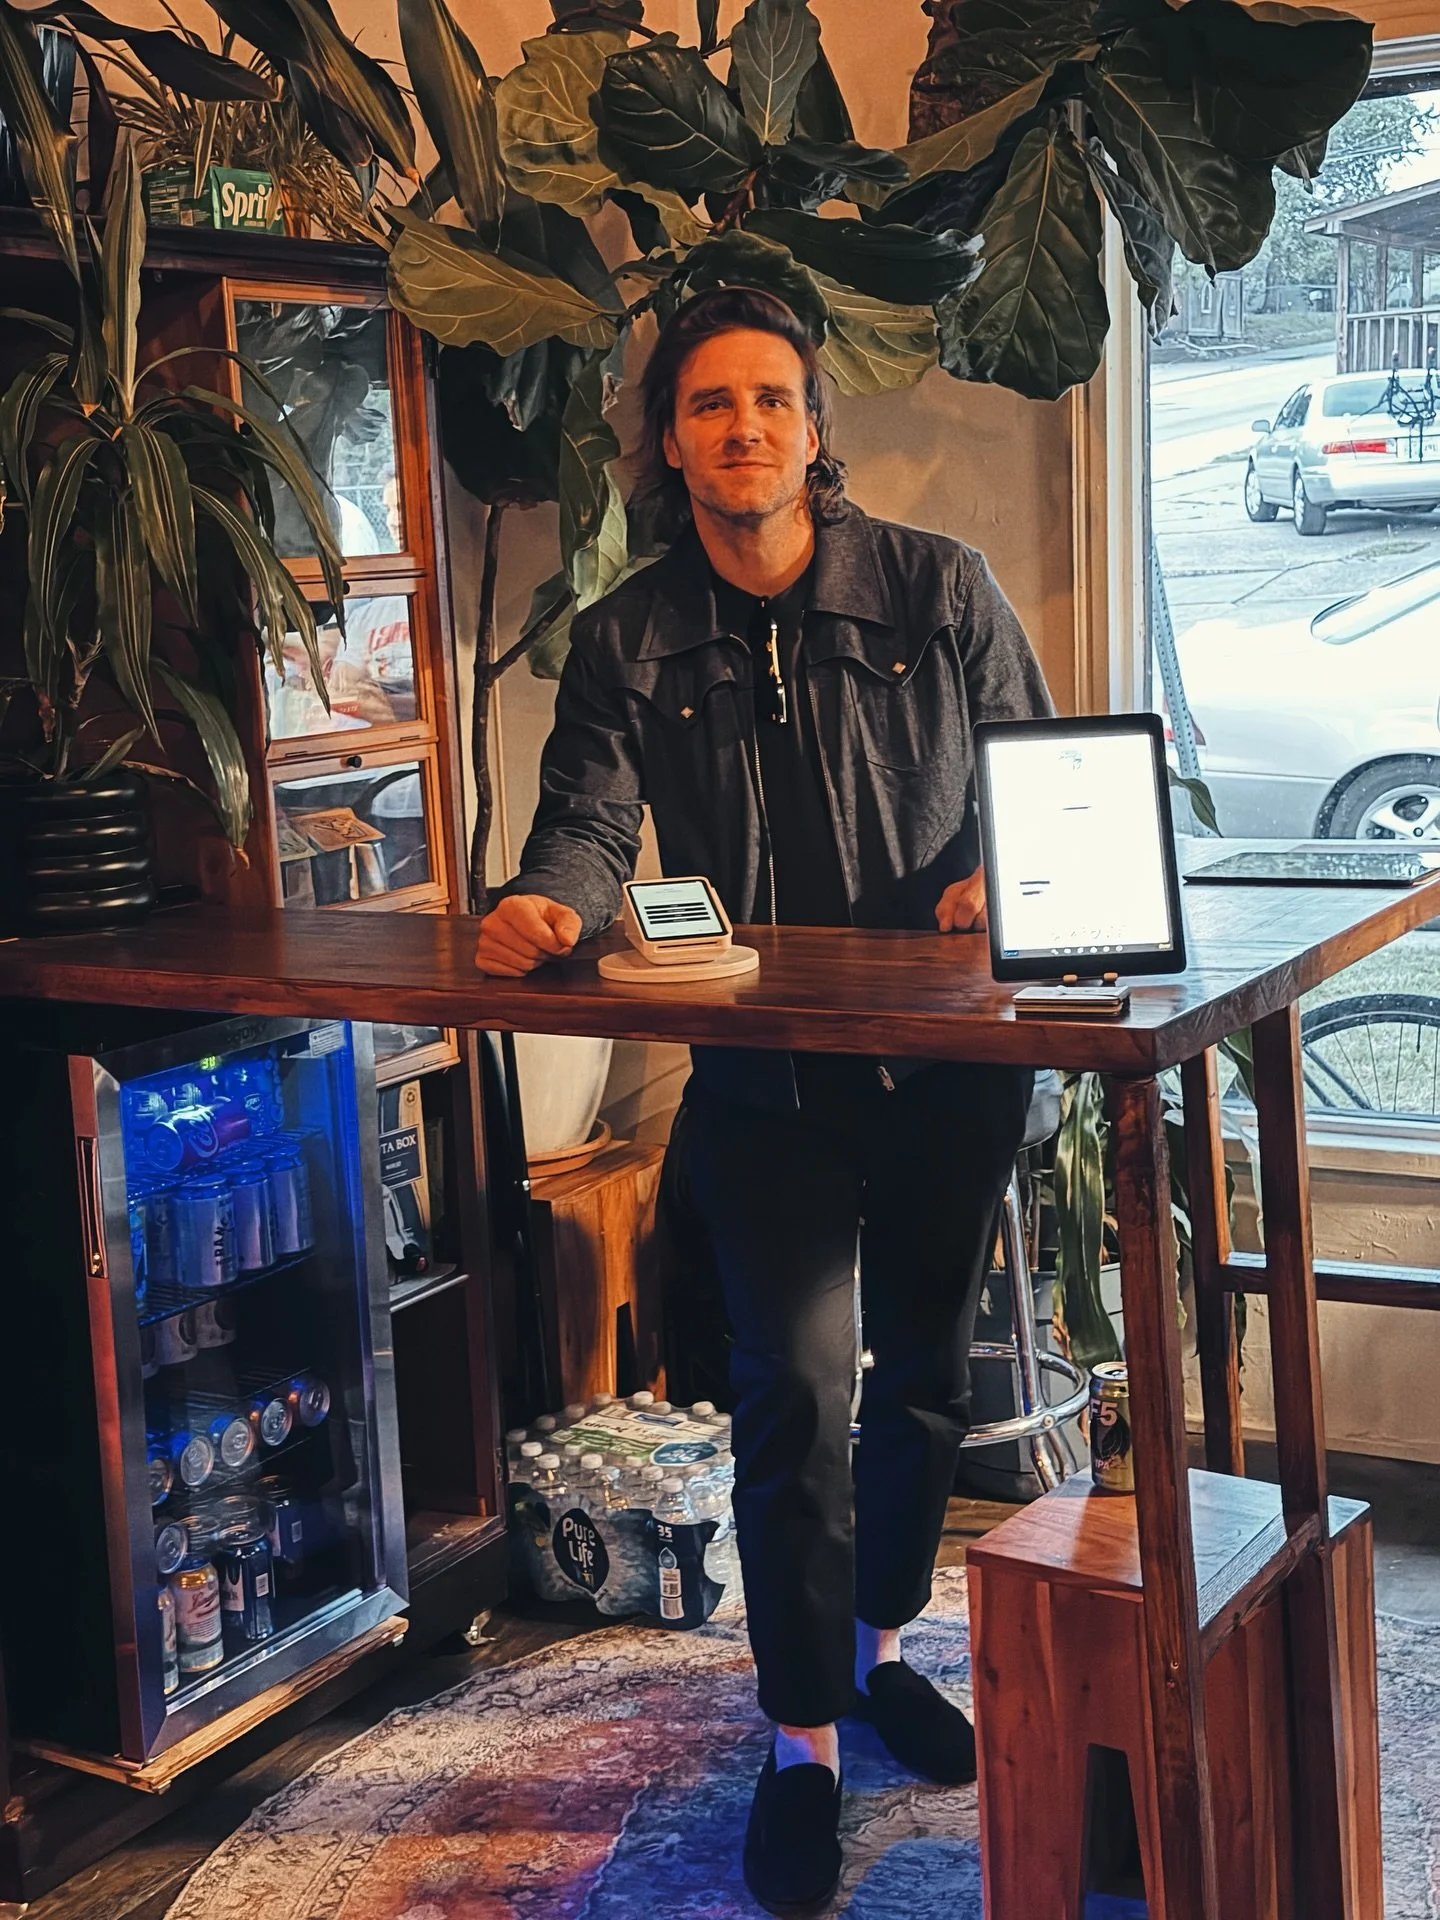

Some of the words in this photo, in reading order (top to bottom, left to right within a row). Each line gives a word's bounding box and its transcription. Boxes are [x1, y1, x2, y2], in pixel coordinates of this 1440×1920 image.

[221, 182, 283, 226] Spri
[396, 1134, 417, 1150] BOX
[1089, 1398, 1119, 1426] F5
[1095, 1459, 1110, 1471] IPA
[562, 1517, 596, 1547] Pure
[657, 1524, 673, 1538] 35
[568, 1541, 594, 1568] Life
